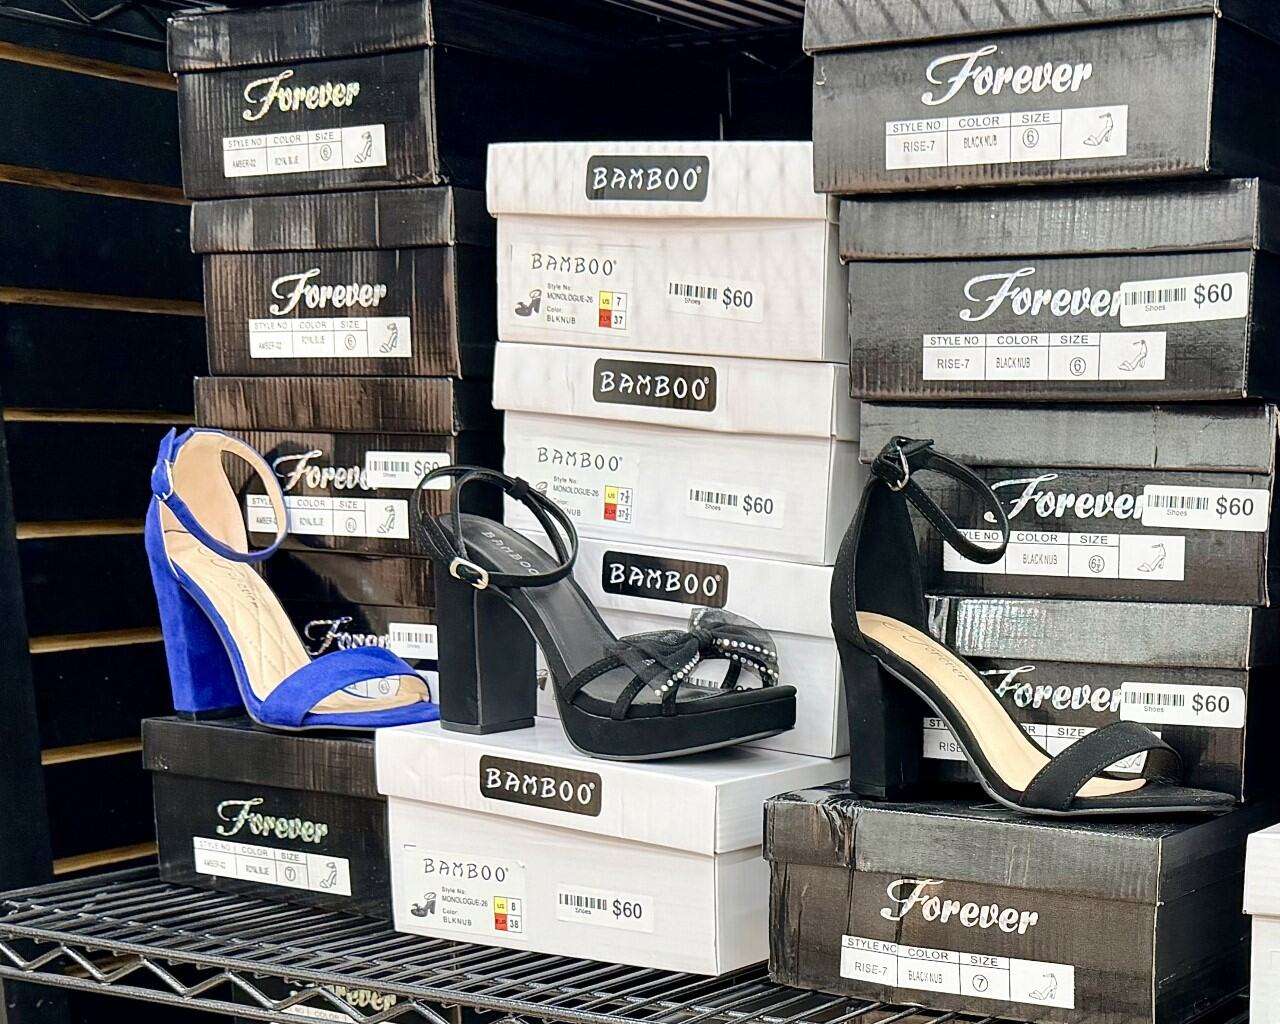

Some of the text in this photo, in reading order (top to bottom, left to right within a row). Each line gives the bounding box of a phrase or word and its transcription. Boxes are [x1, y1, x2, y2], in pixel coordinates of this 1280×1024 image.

[922, 45, 1093, 106] Forever
[243, 70, 359, 121] Forever
[958, 116, 1000, 127] COLOR
[1022, 112, 1050, 123] SIZE
[893, 120, 941, 133] STYLE NO
[273, 134, 301, 143] COLOR
[315, 132, 334, 141] SIZE
[903, 140, 935, 152] RISE-7
[270, 269, 386, 316] Forever
[1194, 283, 1232, 306] $60
[722, 288, 753, 309] $60
[930, 336, 979, 346] STYLE NO
[998, 335, 1038, 344] COLOR
[1060, 334, 1088, 344] SIZE
[937, 358, 969, 369] RISE-7
[743, 494, 773, 515] $60
[1216, 497, 1254, 520] $60
[1017, 532, 1058, 542] COLOR
[1080, 535, 1108, 544] SIZE
[1192, 694, 1229, 713] $60
[1058, 727, 1085, 737] SIZE
[217, 798, 328, 843] Forever
[613, 900, 642, 919] $60
[880, 879, 1038, 934] Forever
[510, 919, 519, 928] 38
[908, 949, 949, 960] COLOR
[971, 956, 998, 966] SIZE
[855, 961, 888, 974] RISE-7
